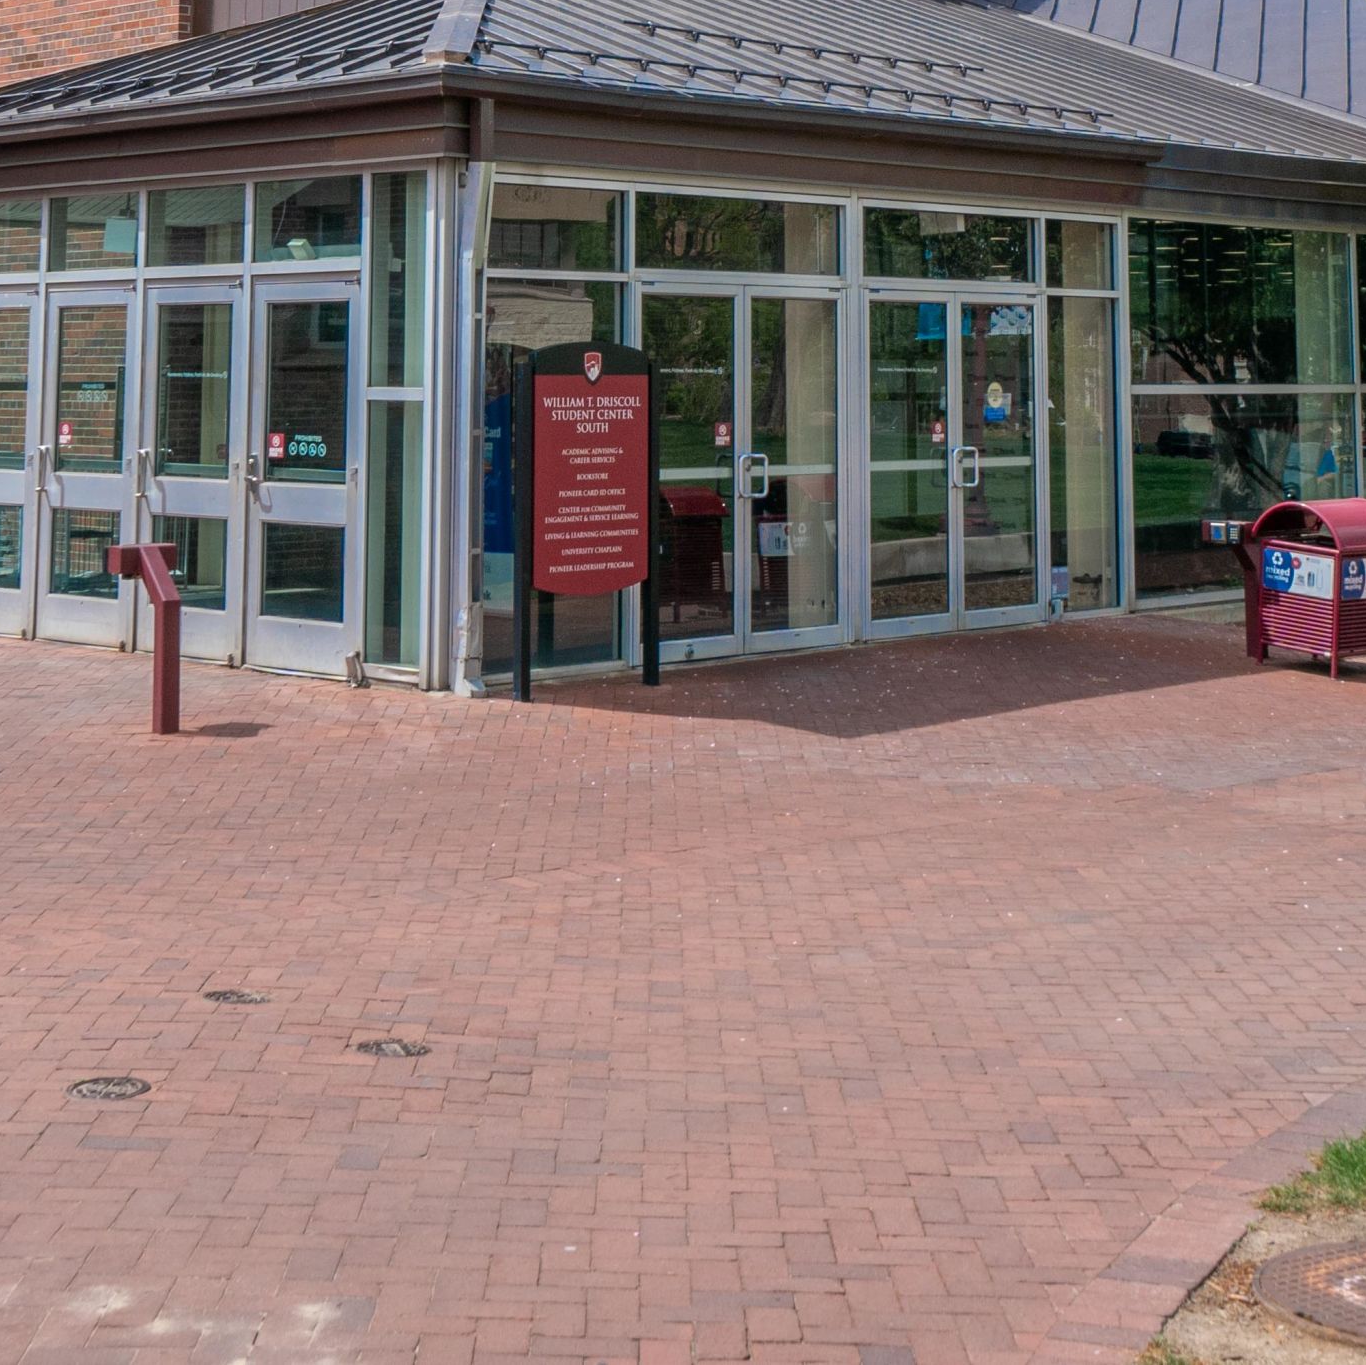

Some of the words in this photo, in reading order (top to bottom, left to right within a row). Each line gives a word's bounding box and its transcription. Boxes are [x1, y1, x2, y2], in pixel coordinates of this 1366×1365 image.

[543, 396, 585, 408] WILLIAM
[586, 396, 595, 407] T.
[596, 396, 641, 407] DRISCOLL
[551, 409, 596, 421] STUDENT
[597, 409, 634, 420] CENTER
[576, 422, 609, 434] SOUTH
[561, 448, 591, 456] ACADEMIC
[591, 447, 618, 455] ADVISING
[569, 457, 591, 465] CAREER
[591, 456, 616, 464] SERVICES
[576, 472, 609, 481] BOOKSTORE
[558, 490, 583, 498] PIONEER
[583, 489, 599, 497] CARD
[599, 488, 607, 496] ID
[607, 488, 626, 496] OFFICE
[558, 506, 581, 514] CENTER
[591, 504, 626, 512] COMMUNITY
[544, 515, 583, 524] ENGAGEMENT
[583, 514, 589, 522] &
[589, 513, 610, 521] SERVICE
[611, 512, 639, 521] LEARNING
[544, 532, 565, 541] LIVING
[565, 531, 571, 540] &
[571, 530, 599, 539] LEARNING
[599, 528, 639, 537] COMMUNITIES
[561, 546, 595, 556] UNIVERSITY
[595, 545, 623, 554] CHAPLAIN
[549, 565, 573, 574] PIONEER
[574, 562, 606, 572] LEADERSHIP
[607, 561, 635, 570] PROGRAM
[1265, 565, 1291, 577] mixed
[1343, 574, 1363, 584] mixed
